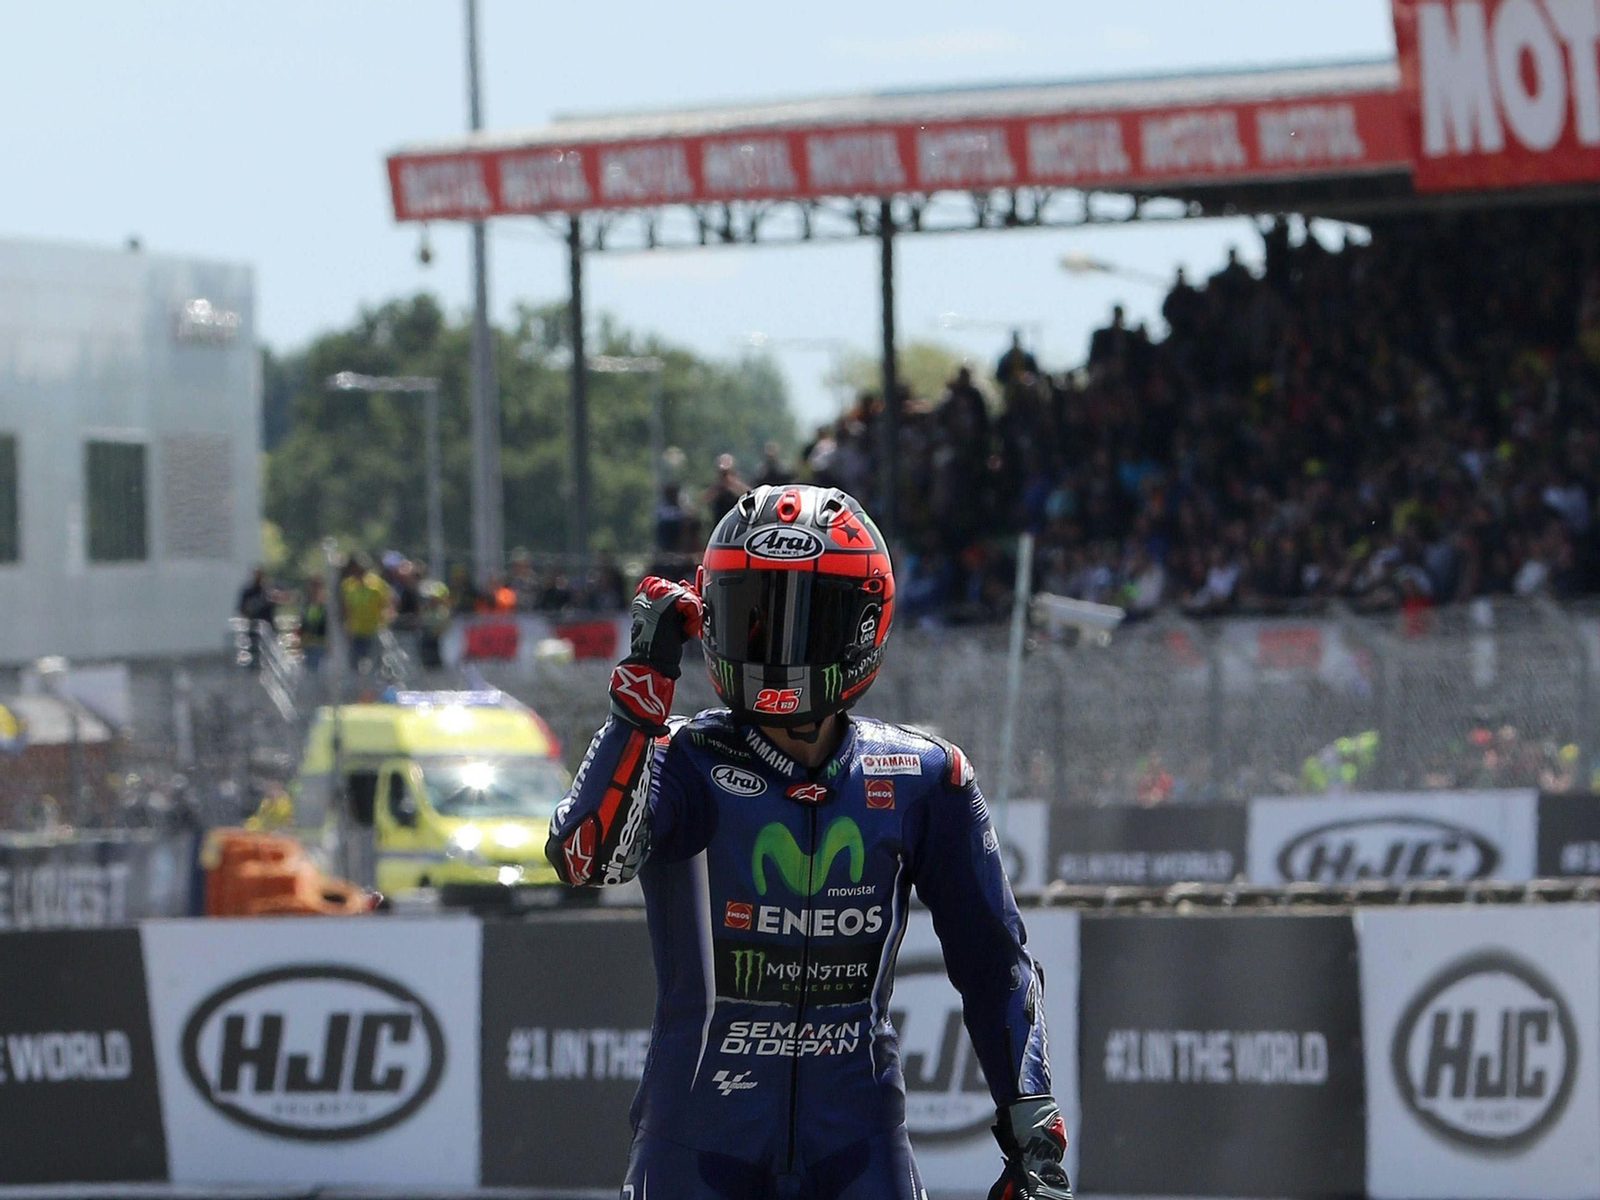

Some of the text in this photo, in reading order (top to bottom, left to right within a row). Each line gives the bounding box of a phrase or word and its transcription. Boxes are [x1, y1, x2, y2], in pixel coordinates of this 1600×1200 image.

[752, 530, 814, 551] Arai
[753, 688, 802, 714] 25
[745, 729, 795, 777] YAMAHA
[874, 756, 919, 767] YAMAHA
[715, 769, 761, 790] Arai
[867, 790, 893, 798] ENEOS
[828, 885, 876, 897] movistar
[757, 905, 883, 937] ENEOS
[766, 961, 869, 981] MONSTER
[7, 1031, 131, 1082] WORLD
[220, 1013, 412, 1093] HJC
[756, 1038, 859, 1057] DEPAN
[1234, 1029, 1329, 1084] WORLD
[1424, 1008, 1552, 1098] HJC
